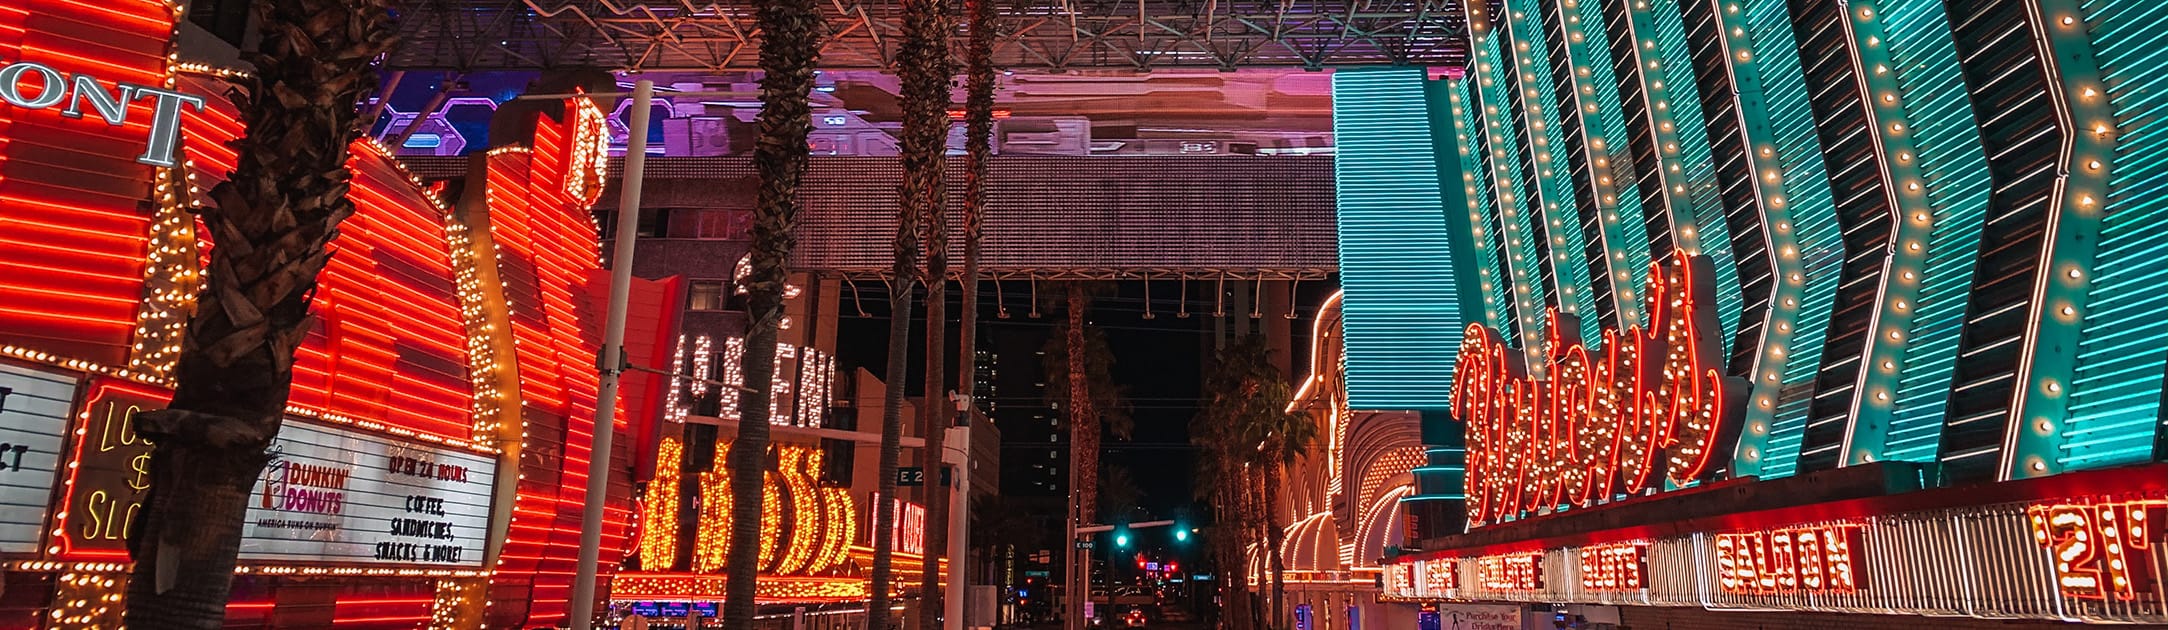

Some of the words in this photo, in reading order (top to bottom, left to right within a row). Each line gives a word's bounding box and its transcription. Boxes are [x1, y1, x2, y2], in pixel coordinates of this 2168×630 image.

[389, 456, 417, 477] OPEN
[420, 461, 434, 479] 24
[437, 464, 469, 484] HOURS
[285, 488, 342, 514] DONUTS
[406, 495, 445, 518] COFFEE,
[375, 542, 417, 562] SNACKS
[1716, 525, 1854, 595] SALOON
[1582, 544, 1639, 592] SLOTS
